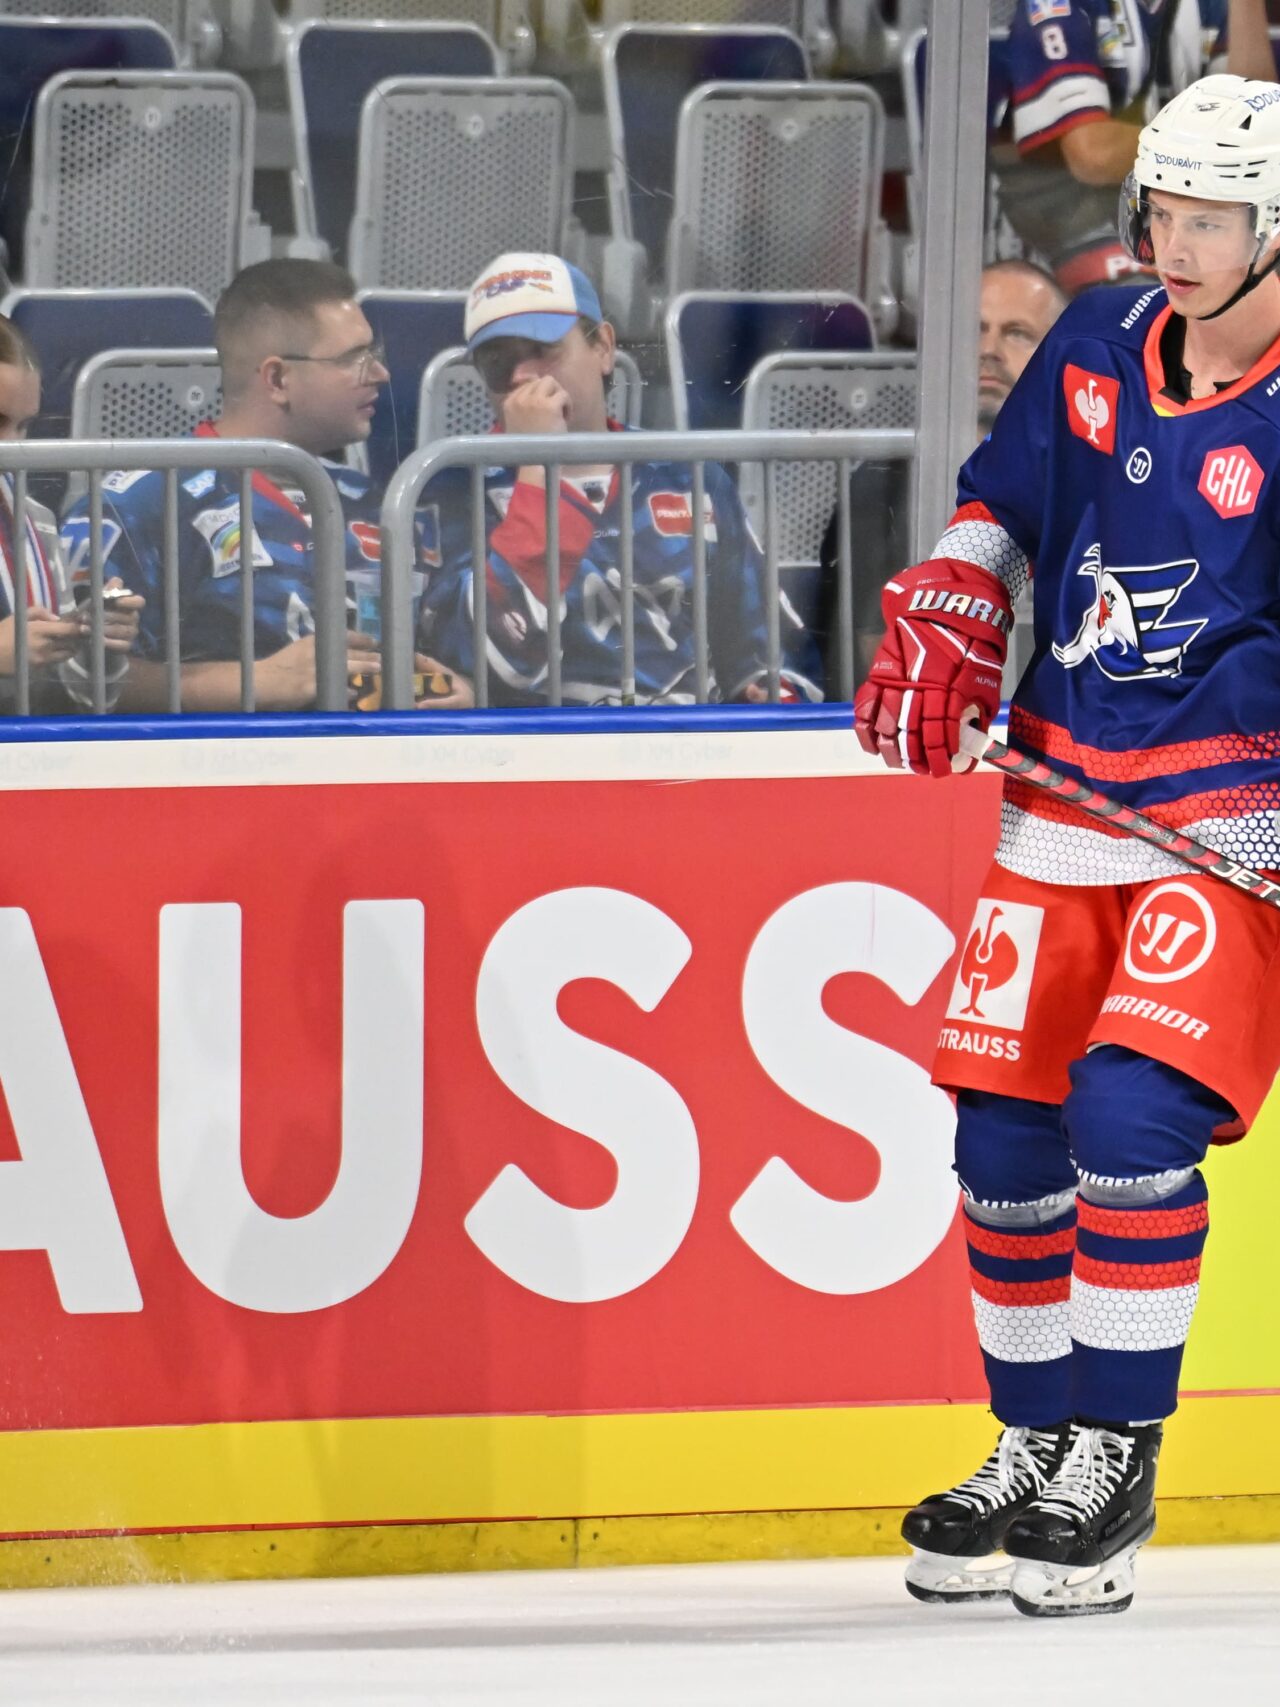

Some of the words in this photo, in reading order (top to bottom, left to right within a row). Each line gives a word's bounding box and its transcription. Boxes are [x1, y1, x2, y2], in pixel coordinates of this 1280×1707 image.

[1042, 25, 1068, 60] 8
[1166, 157, 1202, 171] DURAVIT
[1205, 458, 1252, 508] CHL
